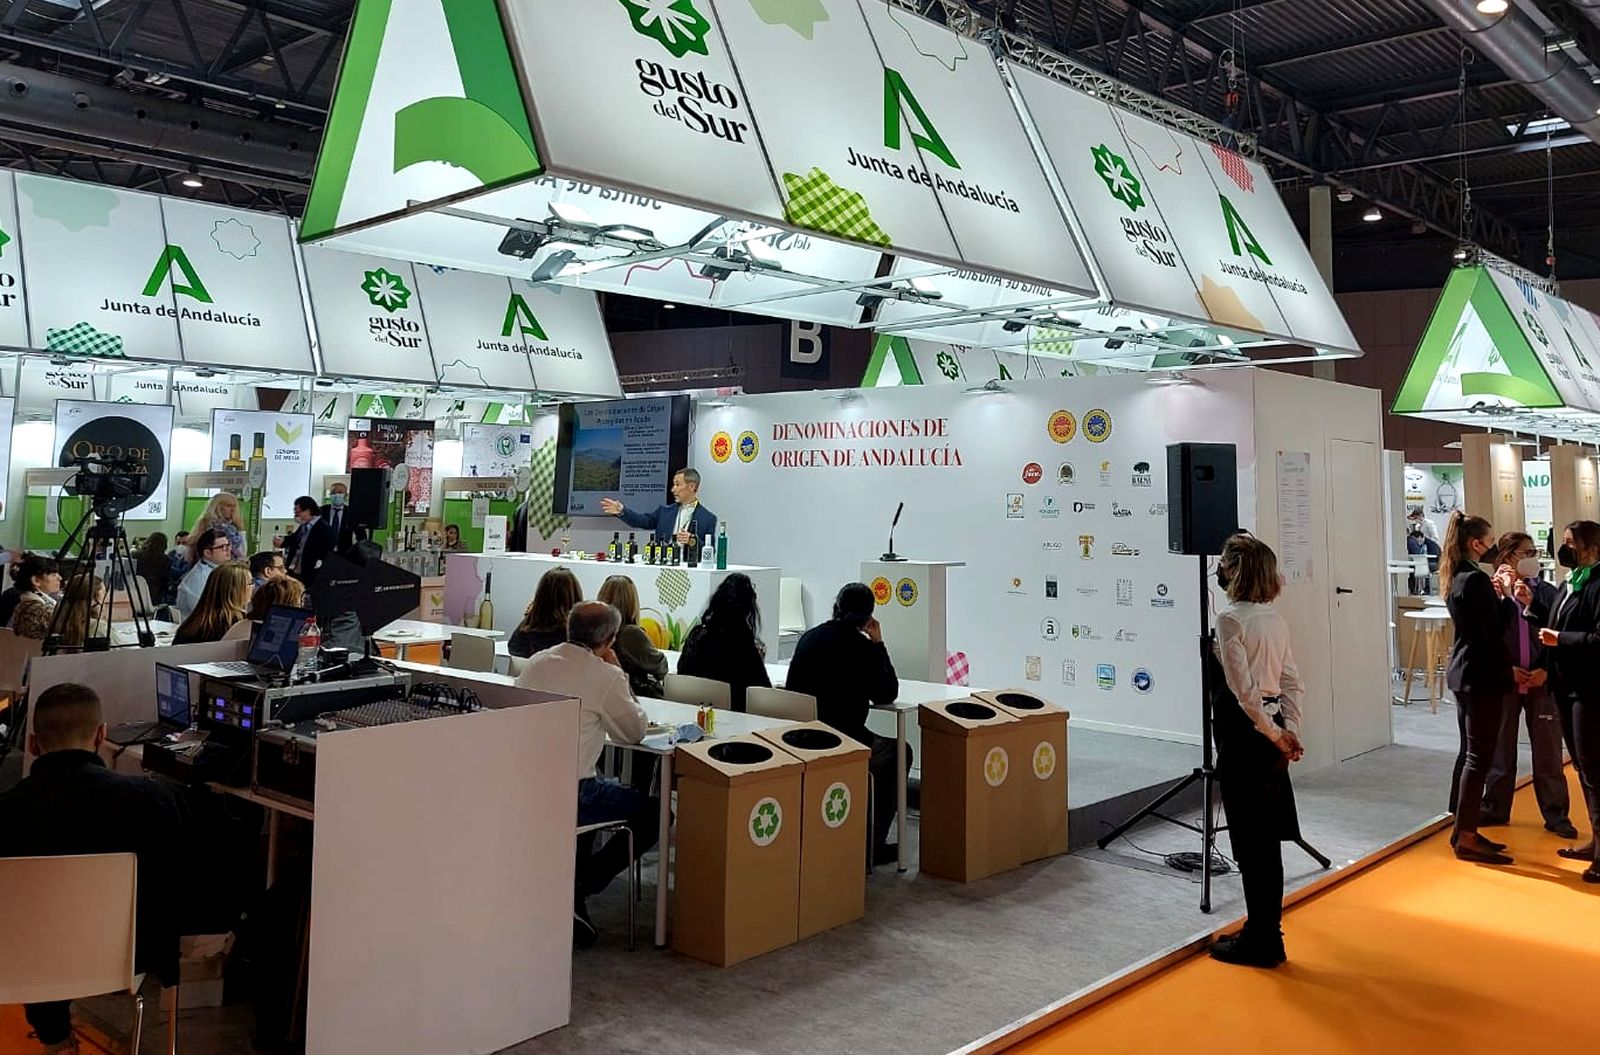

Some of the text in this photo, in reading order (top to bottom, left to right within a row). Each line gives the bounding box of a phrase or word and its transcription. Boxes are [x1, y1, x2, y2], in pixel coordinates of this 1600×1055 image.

[635, 58, 738, 109] gusto
[653, 96, 747, 144] del Sur
[848, 147, 1020, 213] Junta de Andalucía
[1120, 216, 1167, 243] gusto
[1142, 239, 1177, 267] Sur
[1219, 259, 1308, 294] Junta de Andalucía
[101, 299, 261, 327] Junta de Andalucía
[369, 316, 420, 334] gusto
[374, 330, 422, 348] del Sur
[477, 339, 583, 360] Junta de Andalucía
[60, 377, 88, 389] Sur
[135, 381, 164, 391] Junta
[180, 384, 228, 395] Andalucía
[772, 418, 949, 441] DENOMINACIONES DE
[771, 443, 963, 468] ORIGEN DE ANDALUCÍA
